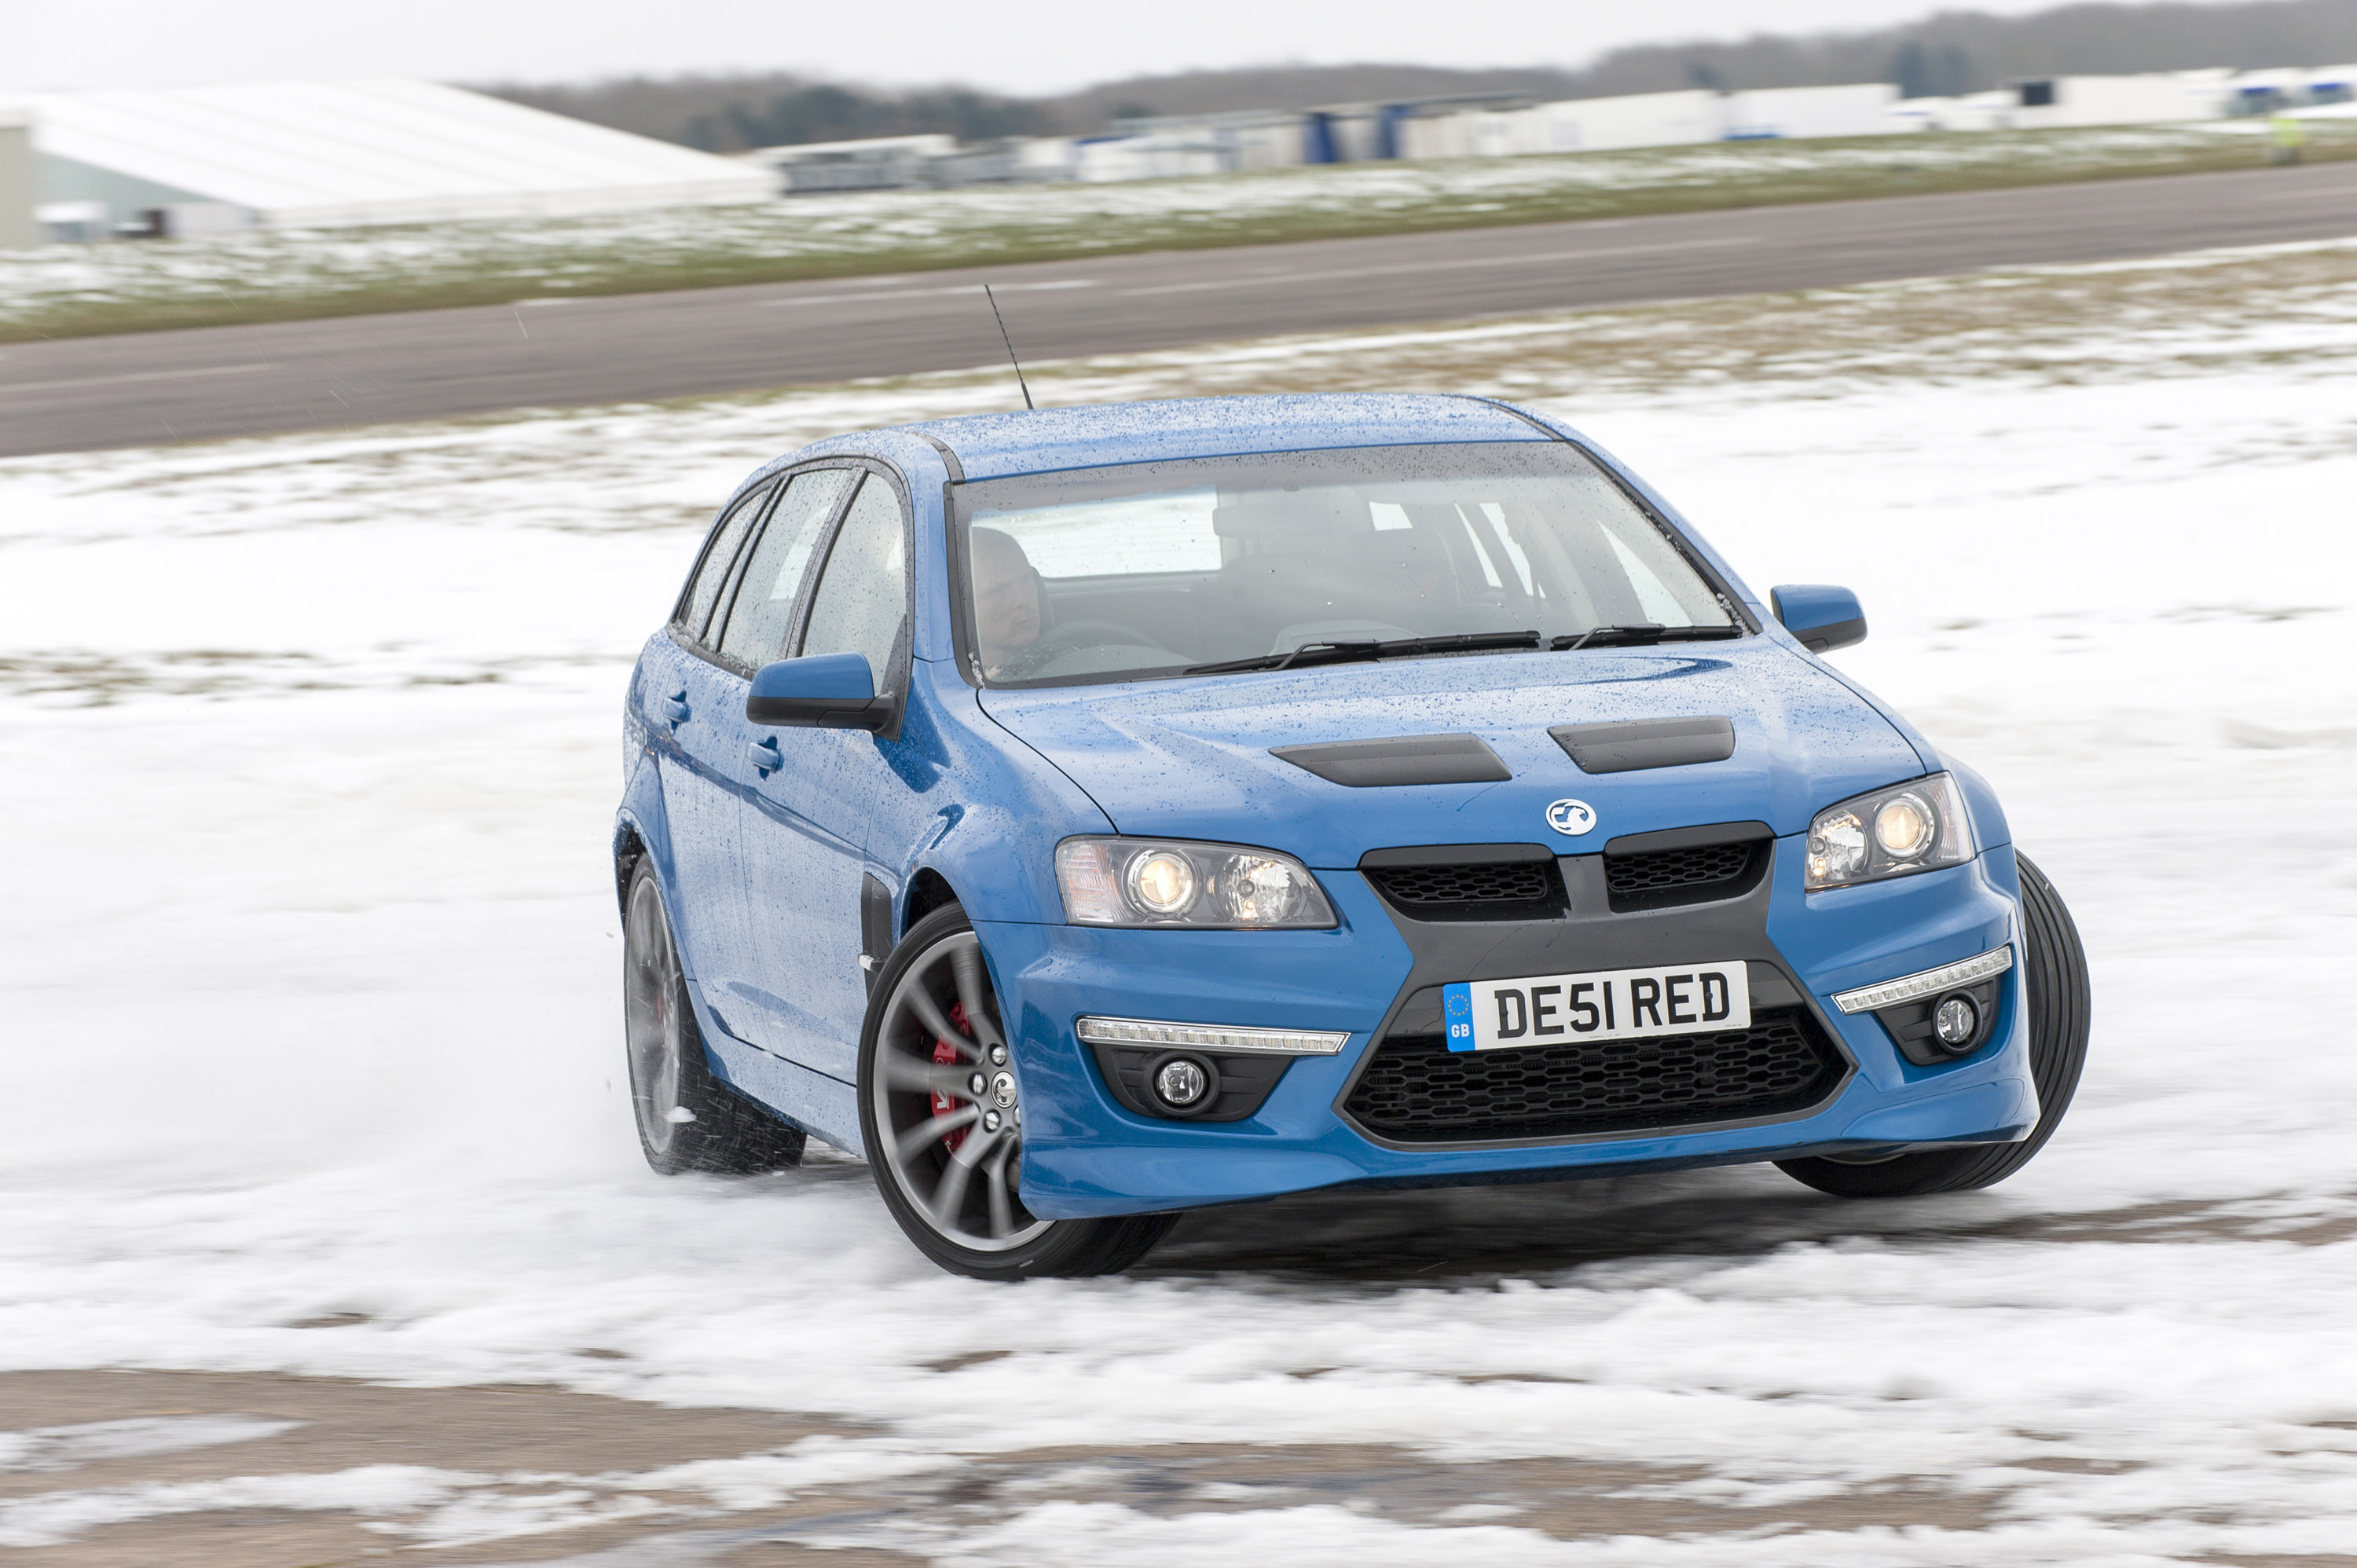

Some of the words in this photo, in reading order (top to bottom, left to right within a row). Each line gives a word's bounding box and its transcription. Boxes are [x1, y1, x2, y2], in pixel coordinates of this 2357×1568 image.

[1494, 980, 1615, 1039] DE51
[1630, 972, 1730, 1028] RED
[1450, 1024, 1470, 1038] GB
